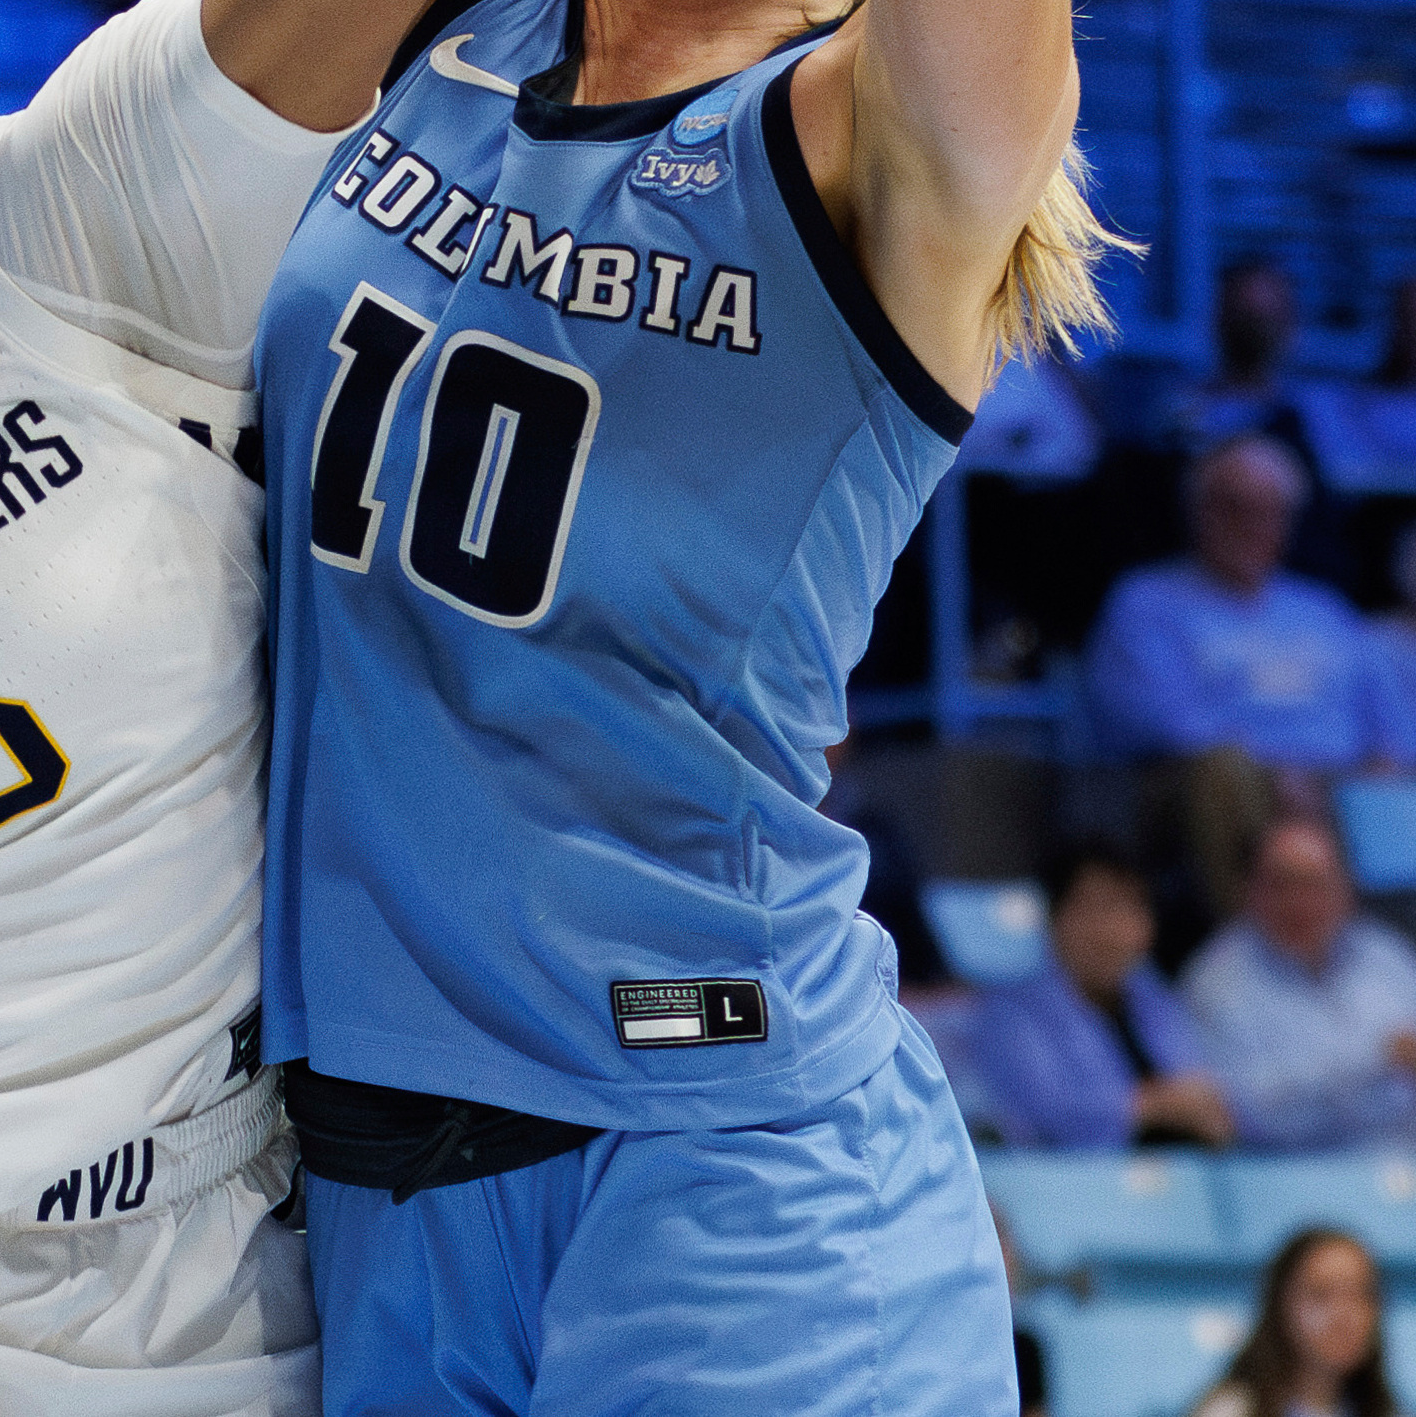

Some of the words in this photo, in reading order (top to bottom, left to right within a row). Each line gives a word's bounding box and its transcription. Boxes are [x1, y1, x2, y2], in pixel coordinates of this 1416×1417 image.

[641, 154, 698, 187] Ivy
[331, 128, 761, 355] COLMBIA
[310, 280, 602, 629] 10
[619, 988, 698, 1001] ENGINEERED
[723, 996, 744, 1023] L
[36, 1136, 154, 1222] WVU
